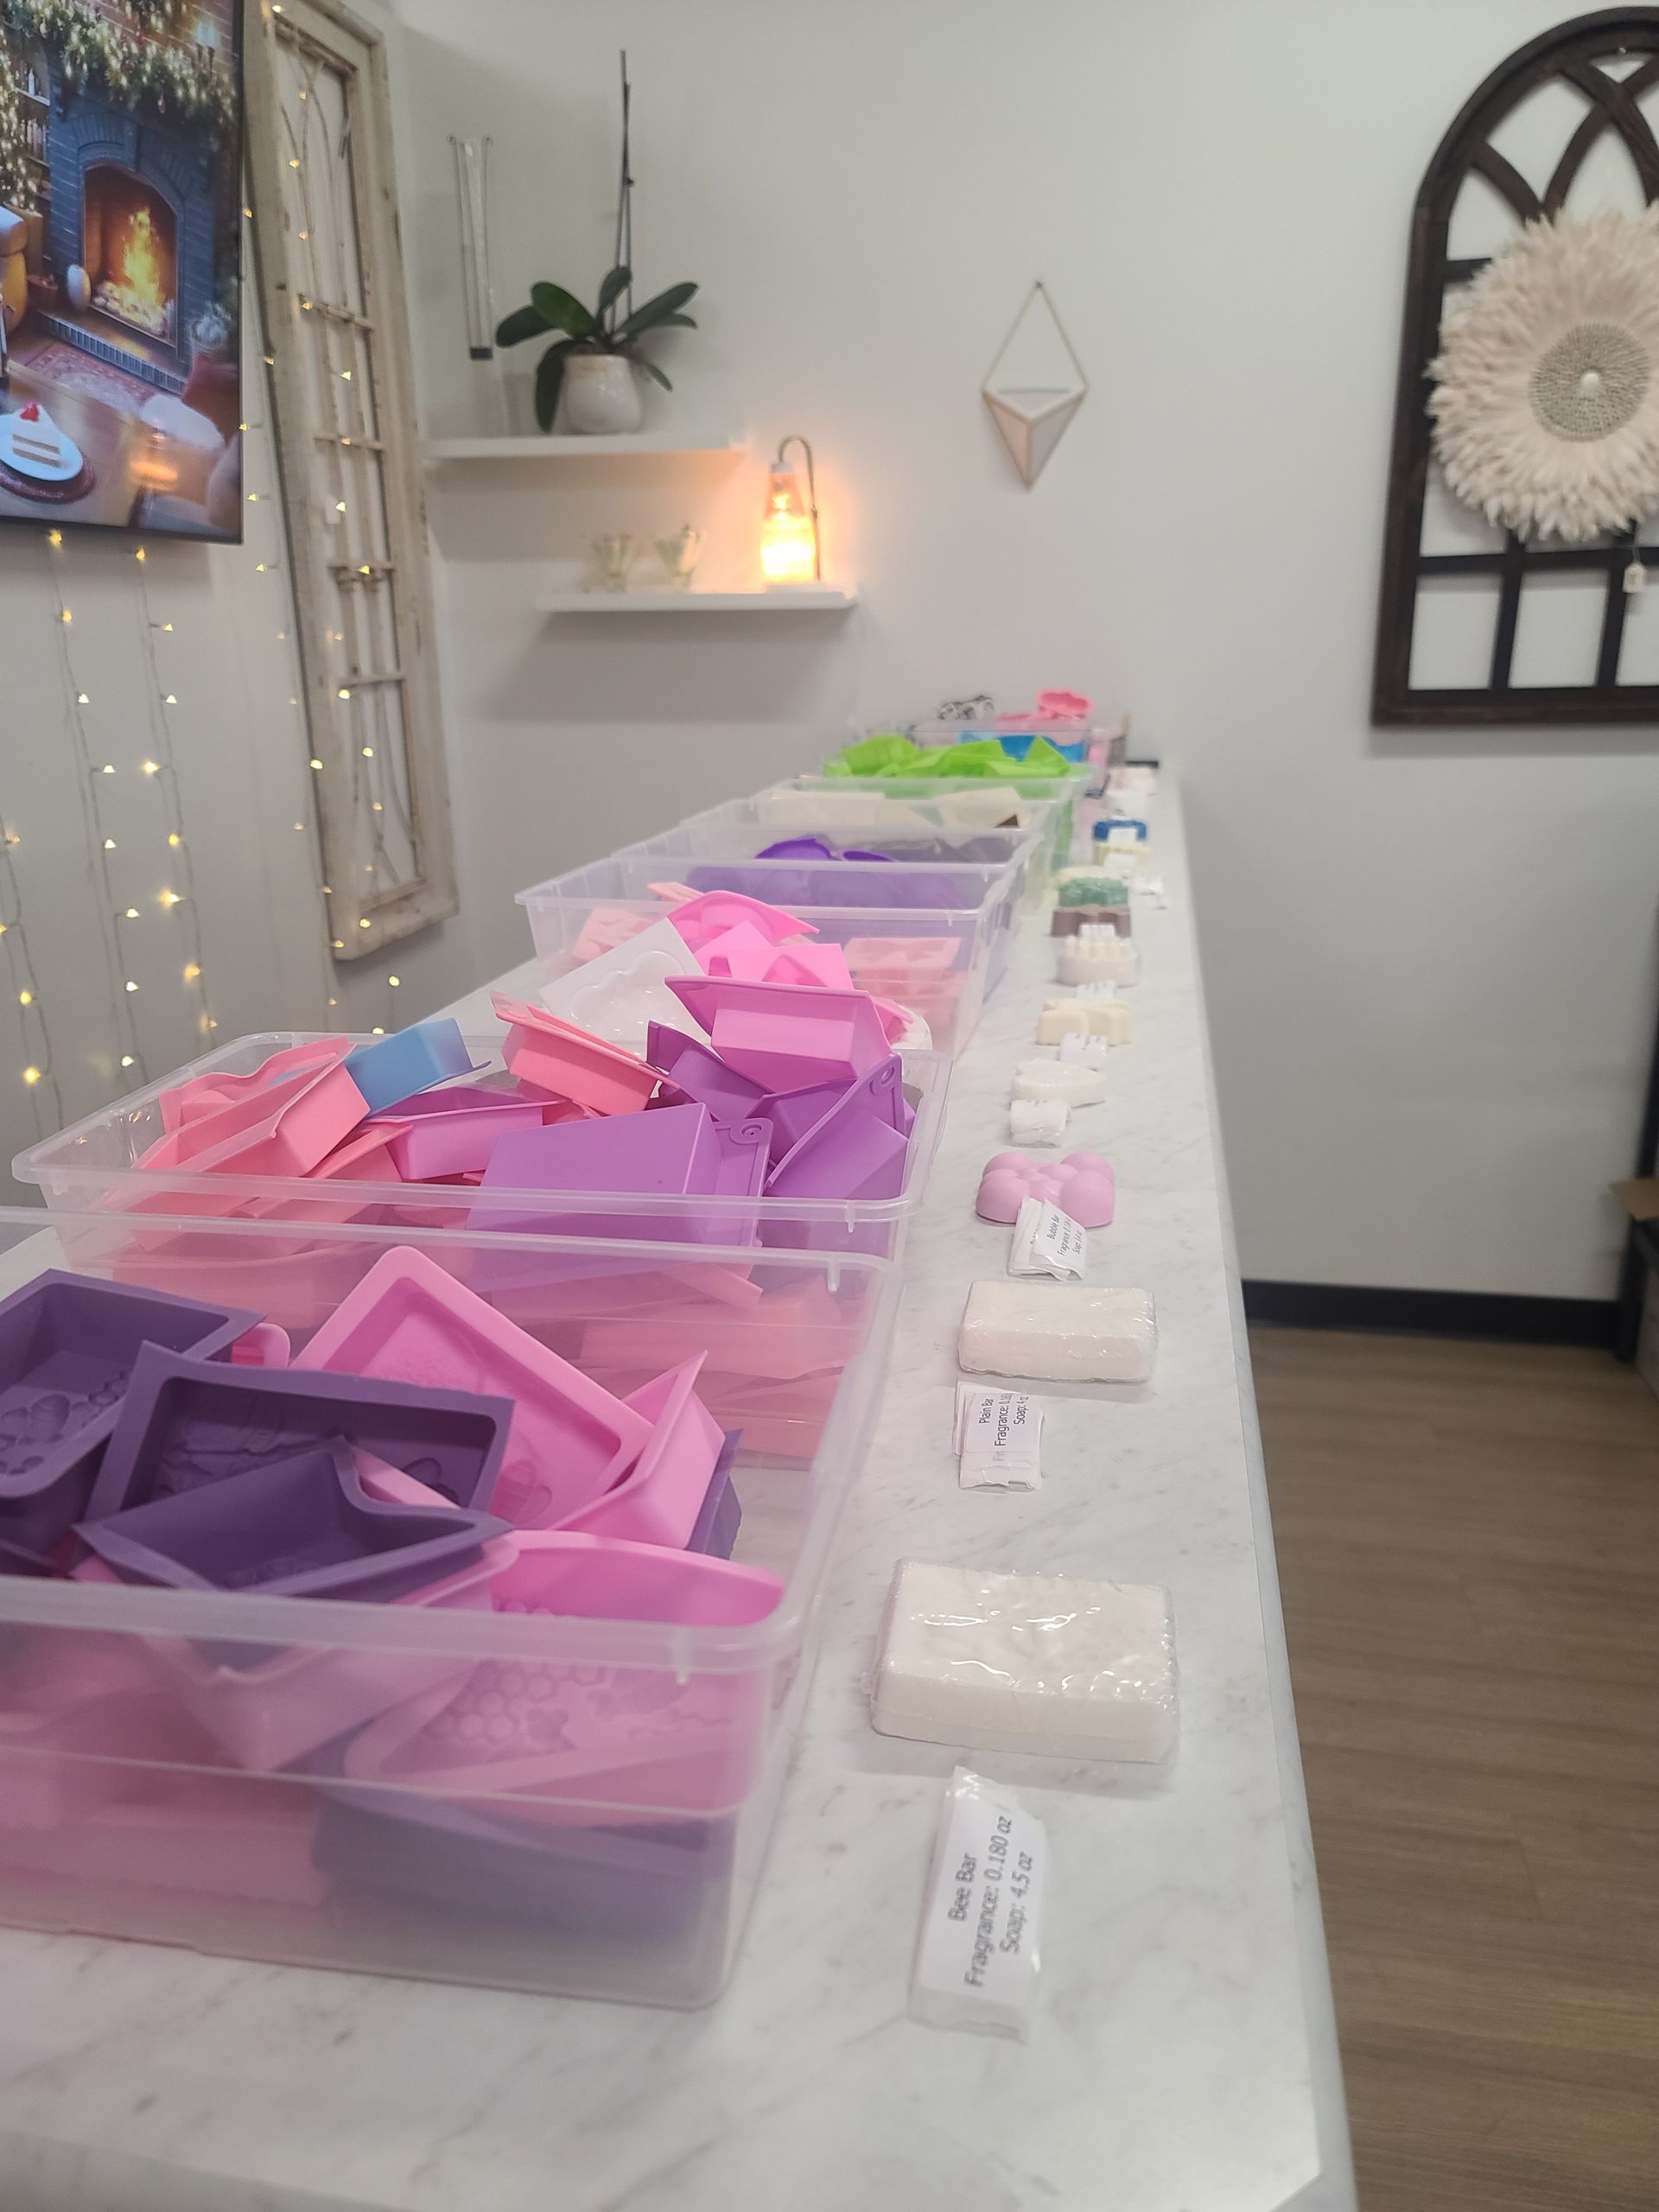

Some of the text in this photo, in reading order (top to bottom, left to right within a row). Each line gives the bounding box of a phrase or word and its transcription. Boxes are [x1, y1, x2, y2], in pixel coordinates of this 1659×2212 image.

[979, 1398, 993, 1424] Plain Bar
[995, 1406, 1010, 1446] Fragrance:
[1014, 1405, 1028, 1425] Soap:
[947, 1852, 977, 1923] Bee Bar
[963, 1815, 1012, 1987] Fragrance: 0.180 oz
[999, 1851, 1033, 1955] Soap: 4.5 oz
